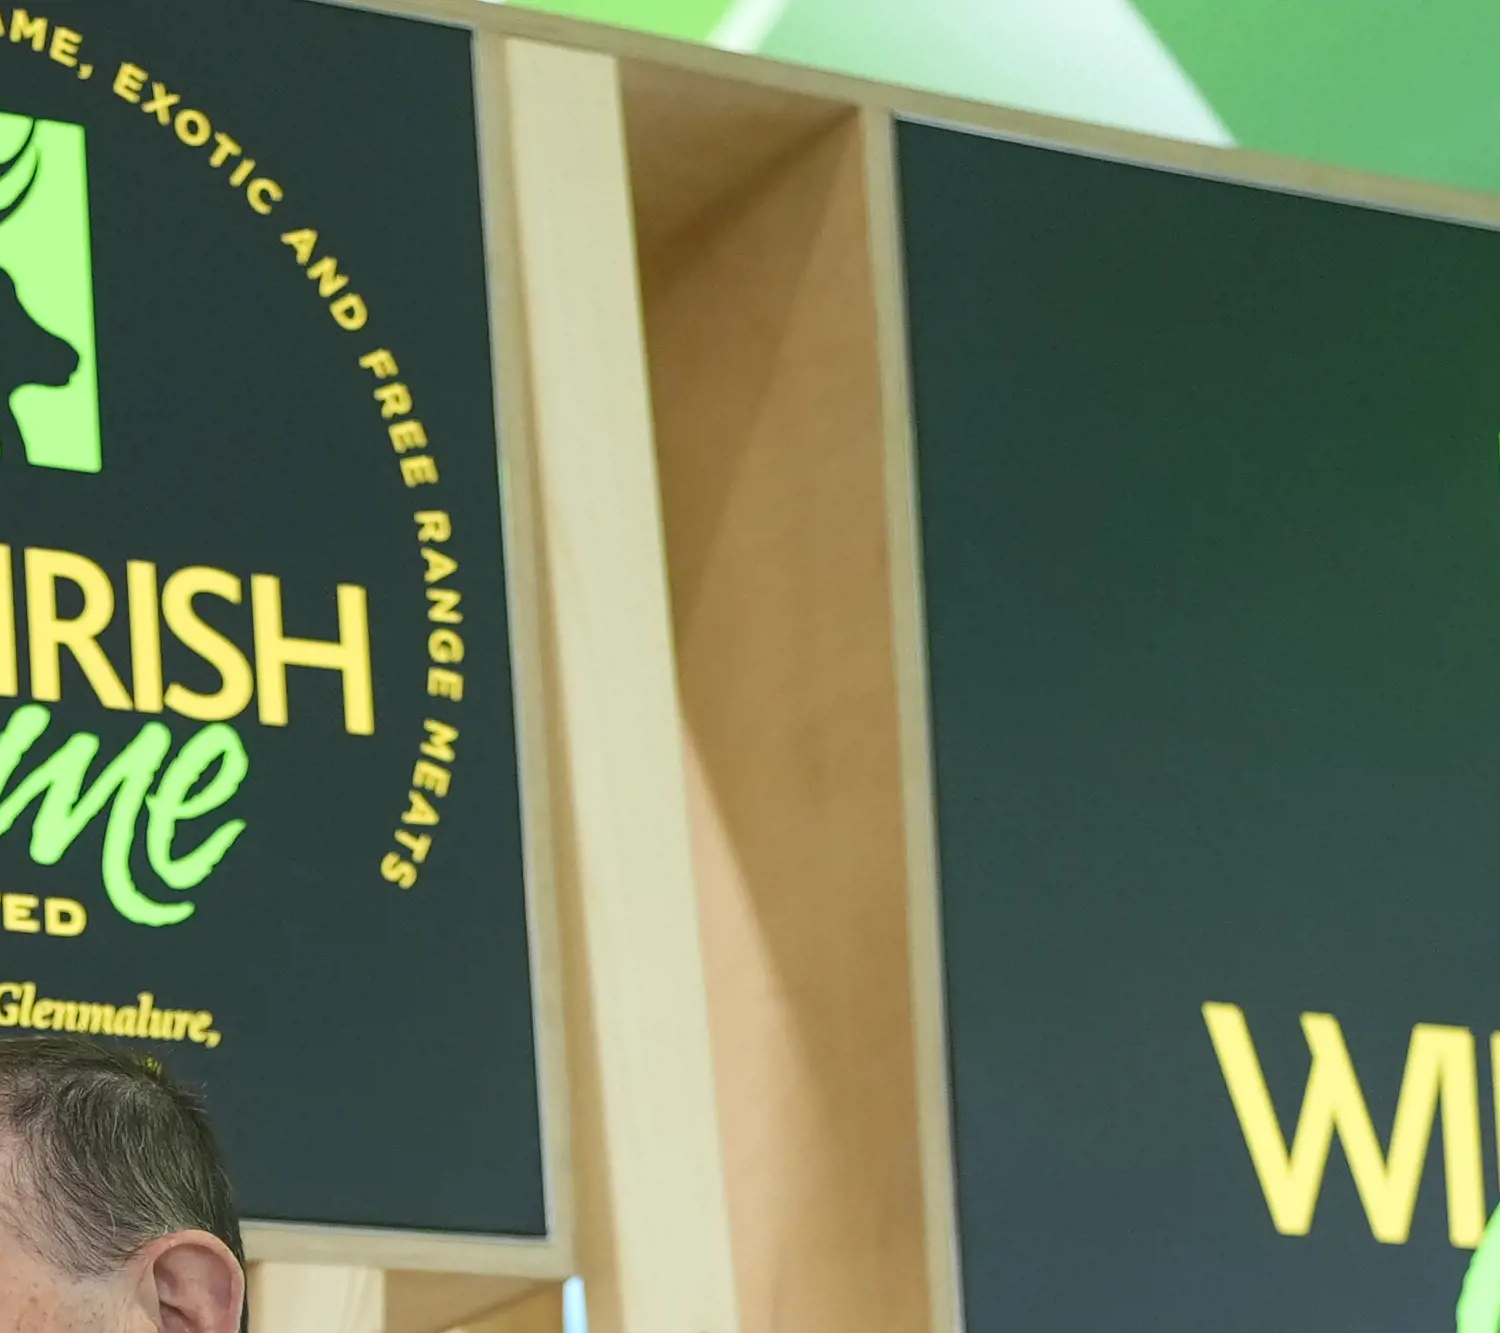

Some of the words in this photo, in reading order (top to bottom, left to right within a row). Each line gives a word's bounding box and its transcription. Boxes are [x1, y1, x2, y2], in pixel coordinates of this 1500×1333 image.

[113, 63, 283, 214] EXOTIC
[281, 228, 367, 330] AND
[359, 349, 438, 487] FREE
[414, 510, 464, 701] RANGE
[381, 719, 458, 888] MEATS
